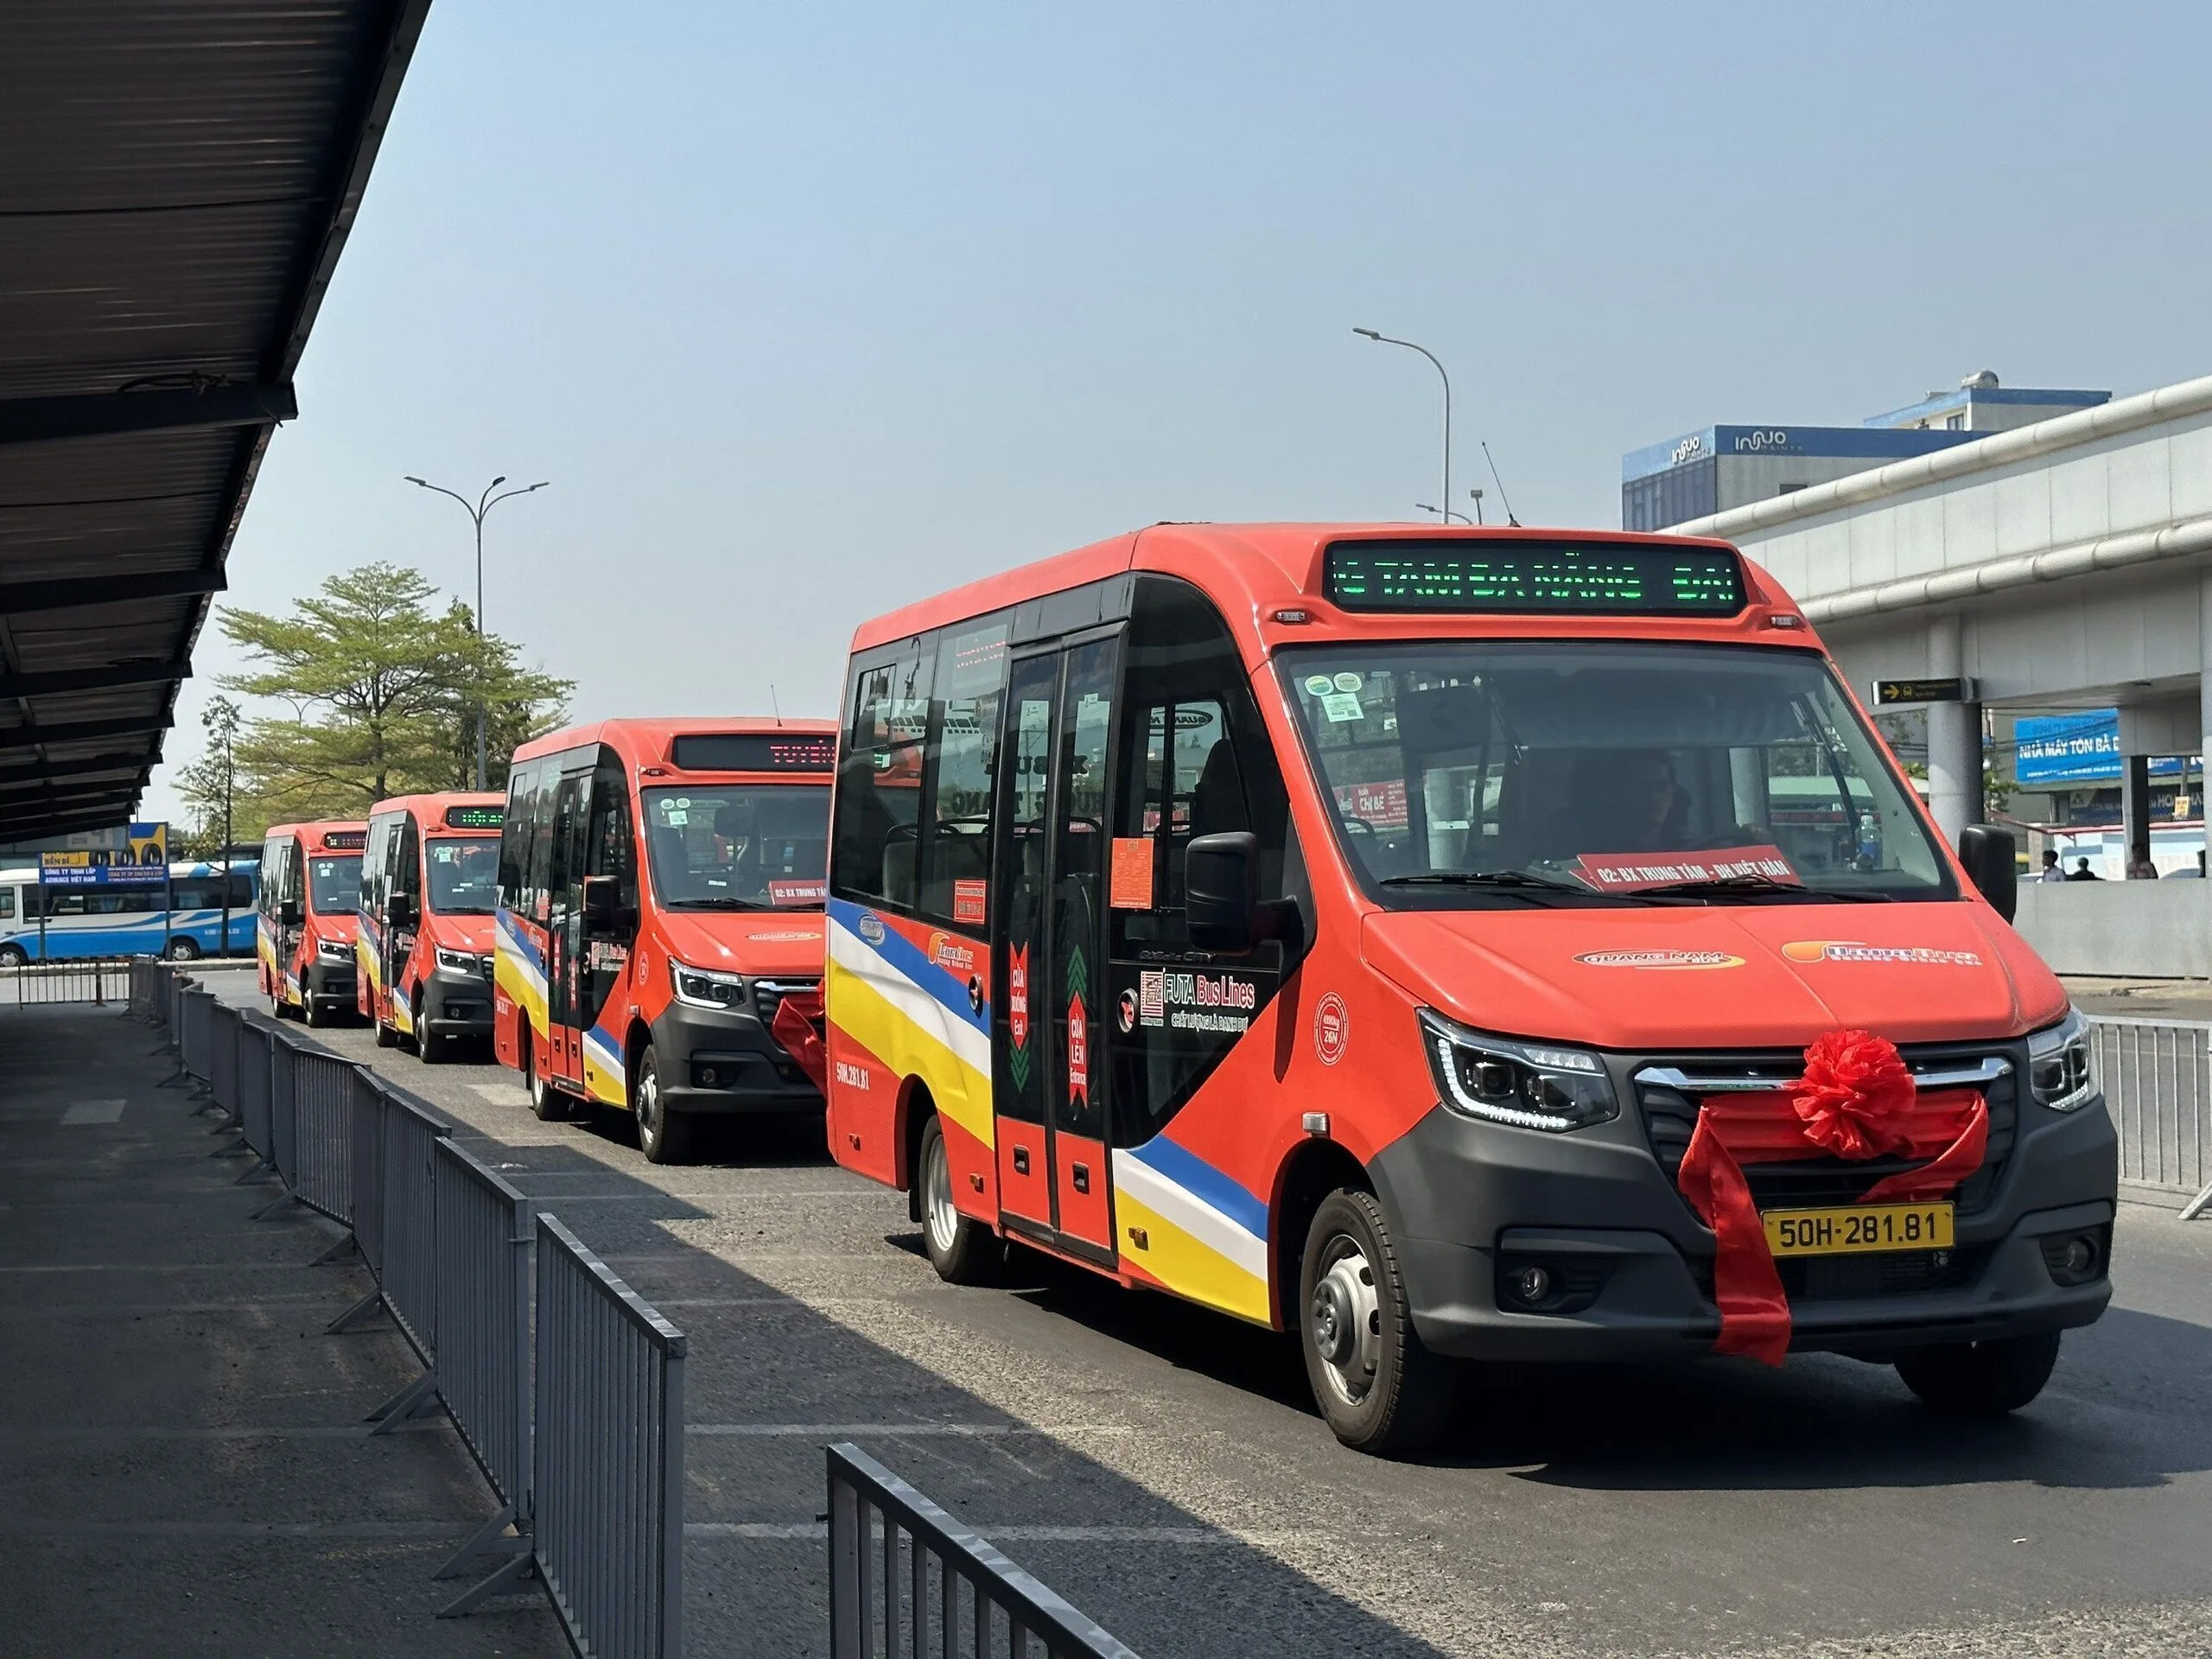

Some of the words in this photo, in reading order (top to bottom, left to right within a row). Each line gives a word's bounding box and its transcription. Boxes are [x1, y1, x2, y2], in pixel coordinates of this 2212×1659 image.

[1597, 868, 1620, 883] 02:
[1620, 867, 1637, 882] BX
[1635, 864, 1677, 882] TRUNG
[1676, 862, 1709, 881] TÂM
[1758, 856, 1790, 877] HÀN
[1164, 973, 1196, 1005] FUTA
[1197, 975, 1221, 1007] Bus
[1221, 976, 1255, 1009] Lines
[1779, 1211, 1936, 1248] 50H-281.81
